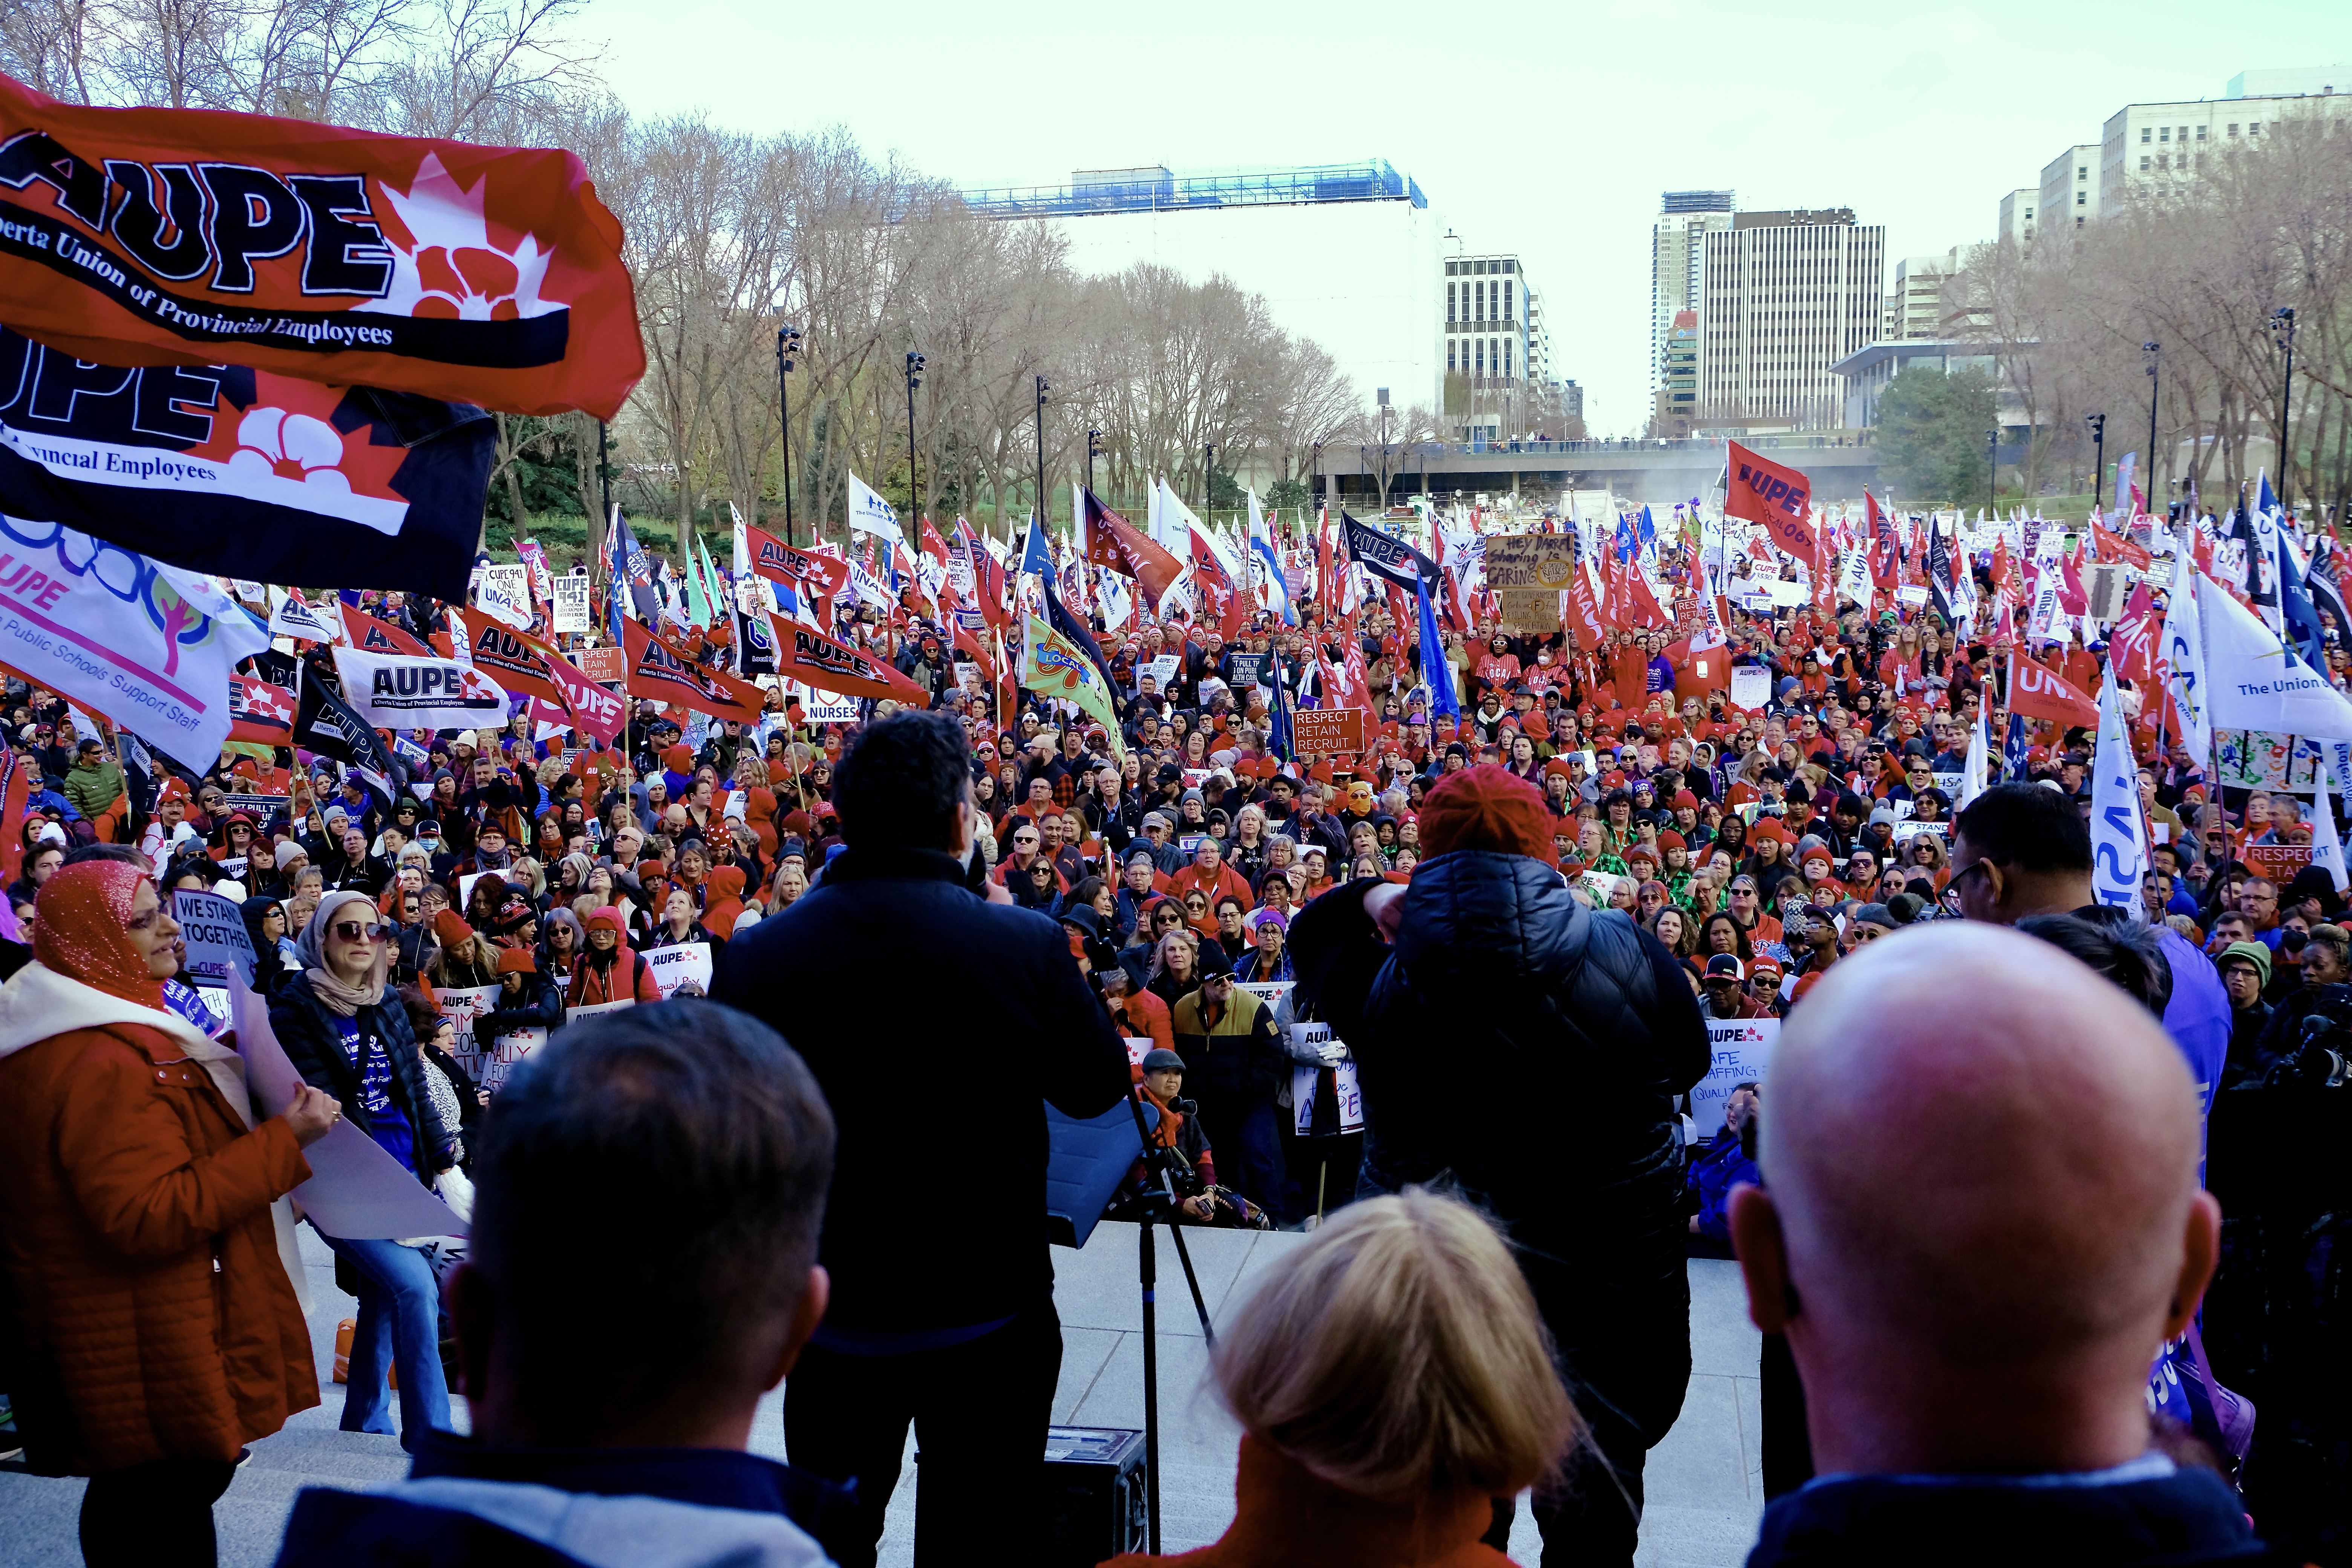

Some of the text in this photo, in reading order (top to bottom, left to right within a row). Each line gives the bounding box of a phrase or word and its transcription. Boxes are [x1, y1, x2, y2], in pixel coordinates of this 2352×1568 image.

[0, 130, 395, 297] AUPE
[55, 232, 392, 346] Union of Provincial Employees
[105, 453, 217, 481] Employees
[1738, 463, 1806, 514] AUPE
[1102, 510, 1167, 561] NURSING CARE
[1507, 537, 1533, 555] HEY
[759, 541, 809, 575] AUPE
[1490, 549, 1539, 571] Sharing
[489, 569, 523, 580] CUPE 941
[1542, 568, 1566, 578] RAISES
[1755, 564, 1778, 574] CUPE
[497, 579, 517, 590] ONE
[556, 578, 588, 591] CUPE
[1547, 576, 1564, 584] TOO!
[485, 588, 511, 608] UNA
[559, 591, 585, 603] 941
[1522, 590, 1558, 600] GOVERNMENT
[1534, 600, 1540, 611] F
[1546, 601, 1556, 610] for
[1506, 612, 1532, 620] FAILING
[475, 655, 490, 663] Alberta
[490, 658, 504, 666] Union
[510, 663, 535, 675] Provincial
[1046, 655, 1081, 672] LOCAL
[3, 619, 202, 732] Public Schools Support Staff
[371, 667, 462, 698] AUPE
[657, 671, 672, 679] Union
[1734, 677, 1765, 691] TIME
[2020, 667, 2073, 700] UN
[2238, 677, 2320, 696] The Union
[568, 684, 622, 725] UPE
[2033, 698, 2058, 707] United
[810, 707, 856, 718] NURSES
[1297, 711, 1350, 724] RESPECT
[1297, 725, 1340, 737] RETAIN
[1298, 738, 1349, 750] RECRUIT
[133, 746, 148, 764] Union
[405, 744, 426, 760] SUPPORT
[179, 897, 242, 926] WE STAND
[182, 923, 252, 951] TOGETHER
[652, 952, 682, 966] AUPE
[198, 961, 225, 975] CUPE
[1754, 962, 1777, 972] Canada
[442, 995, 472, 1007] AUPE
[490, 1042, 531, 1063] RALLY
